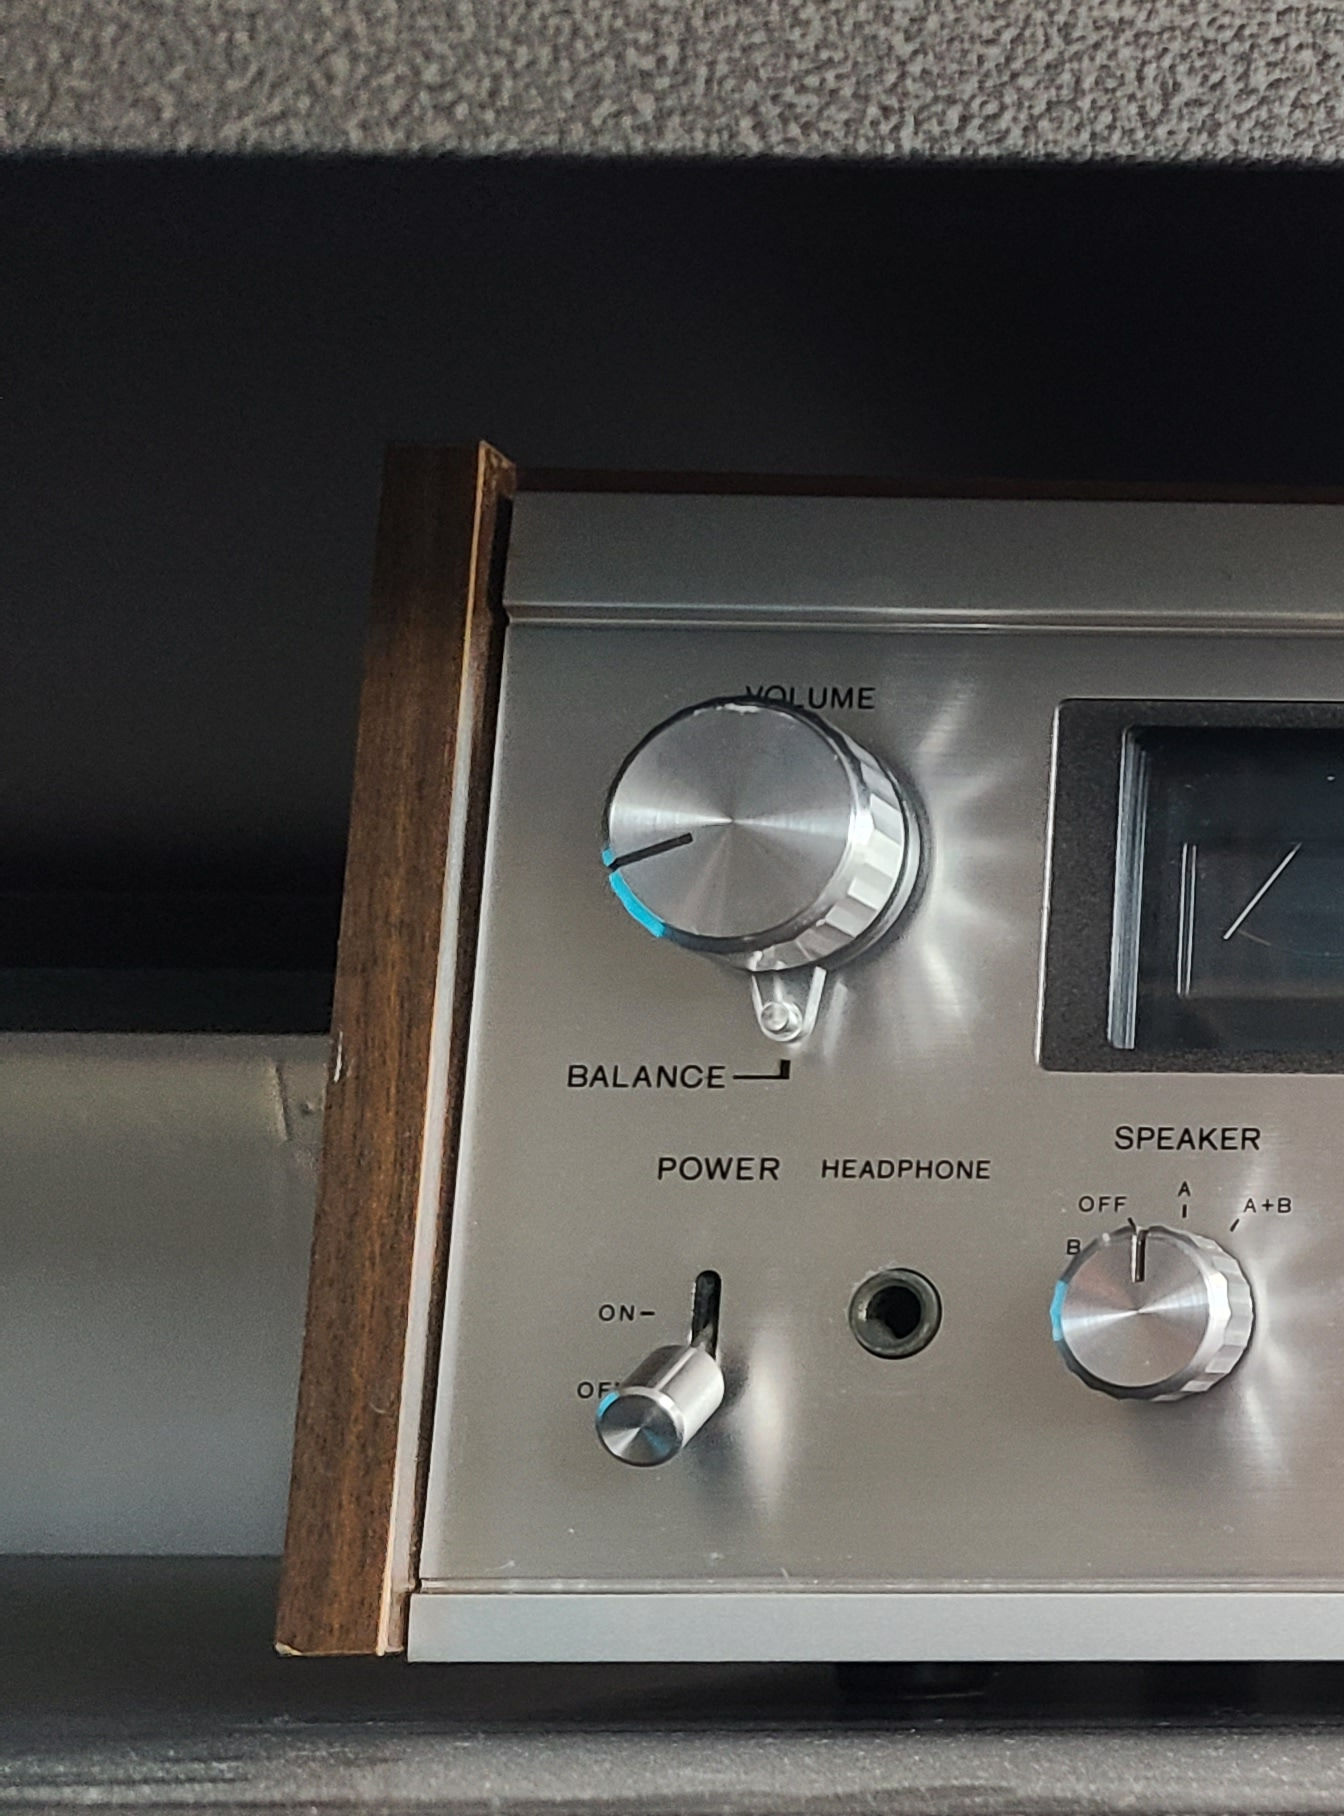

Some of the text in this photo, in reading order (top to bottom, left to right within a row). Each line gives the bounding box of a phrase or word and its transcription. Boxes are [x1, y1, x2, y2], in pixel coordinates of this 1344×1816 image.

[567, 1064, 726, 1089] BALANCE
[1114, 1125, 1261, 1151] SPEAKER
[657, 1156, 780, 1181] POWER
[821, 1159, 991, 1180] HEADPHONE
[1177, 1181, 1191, 1197] A
[1078, 1195, 1127, 1213] OFF
[1243, 1197, 1292, 1214] A+B
[1066, 1239, 1082, 1256] B
[598, 1304, 635, 1322] ON
[577, 1381, 619, 1399] OF
